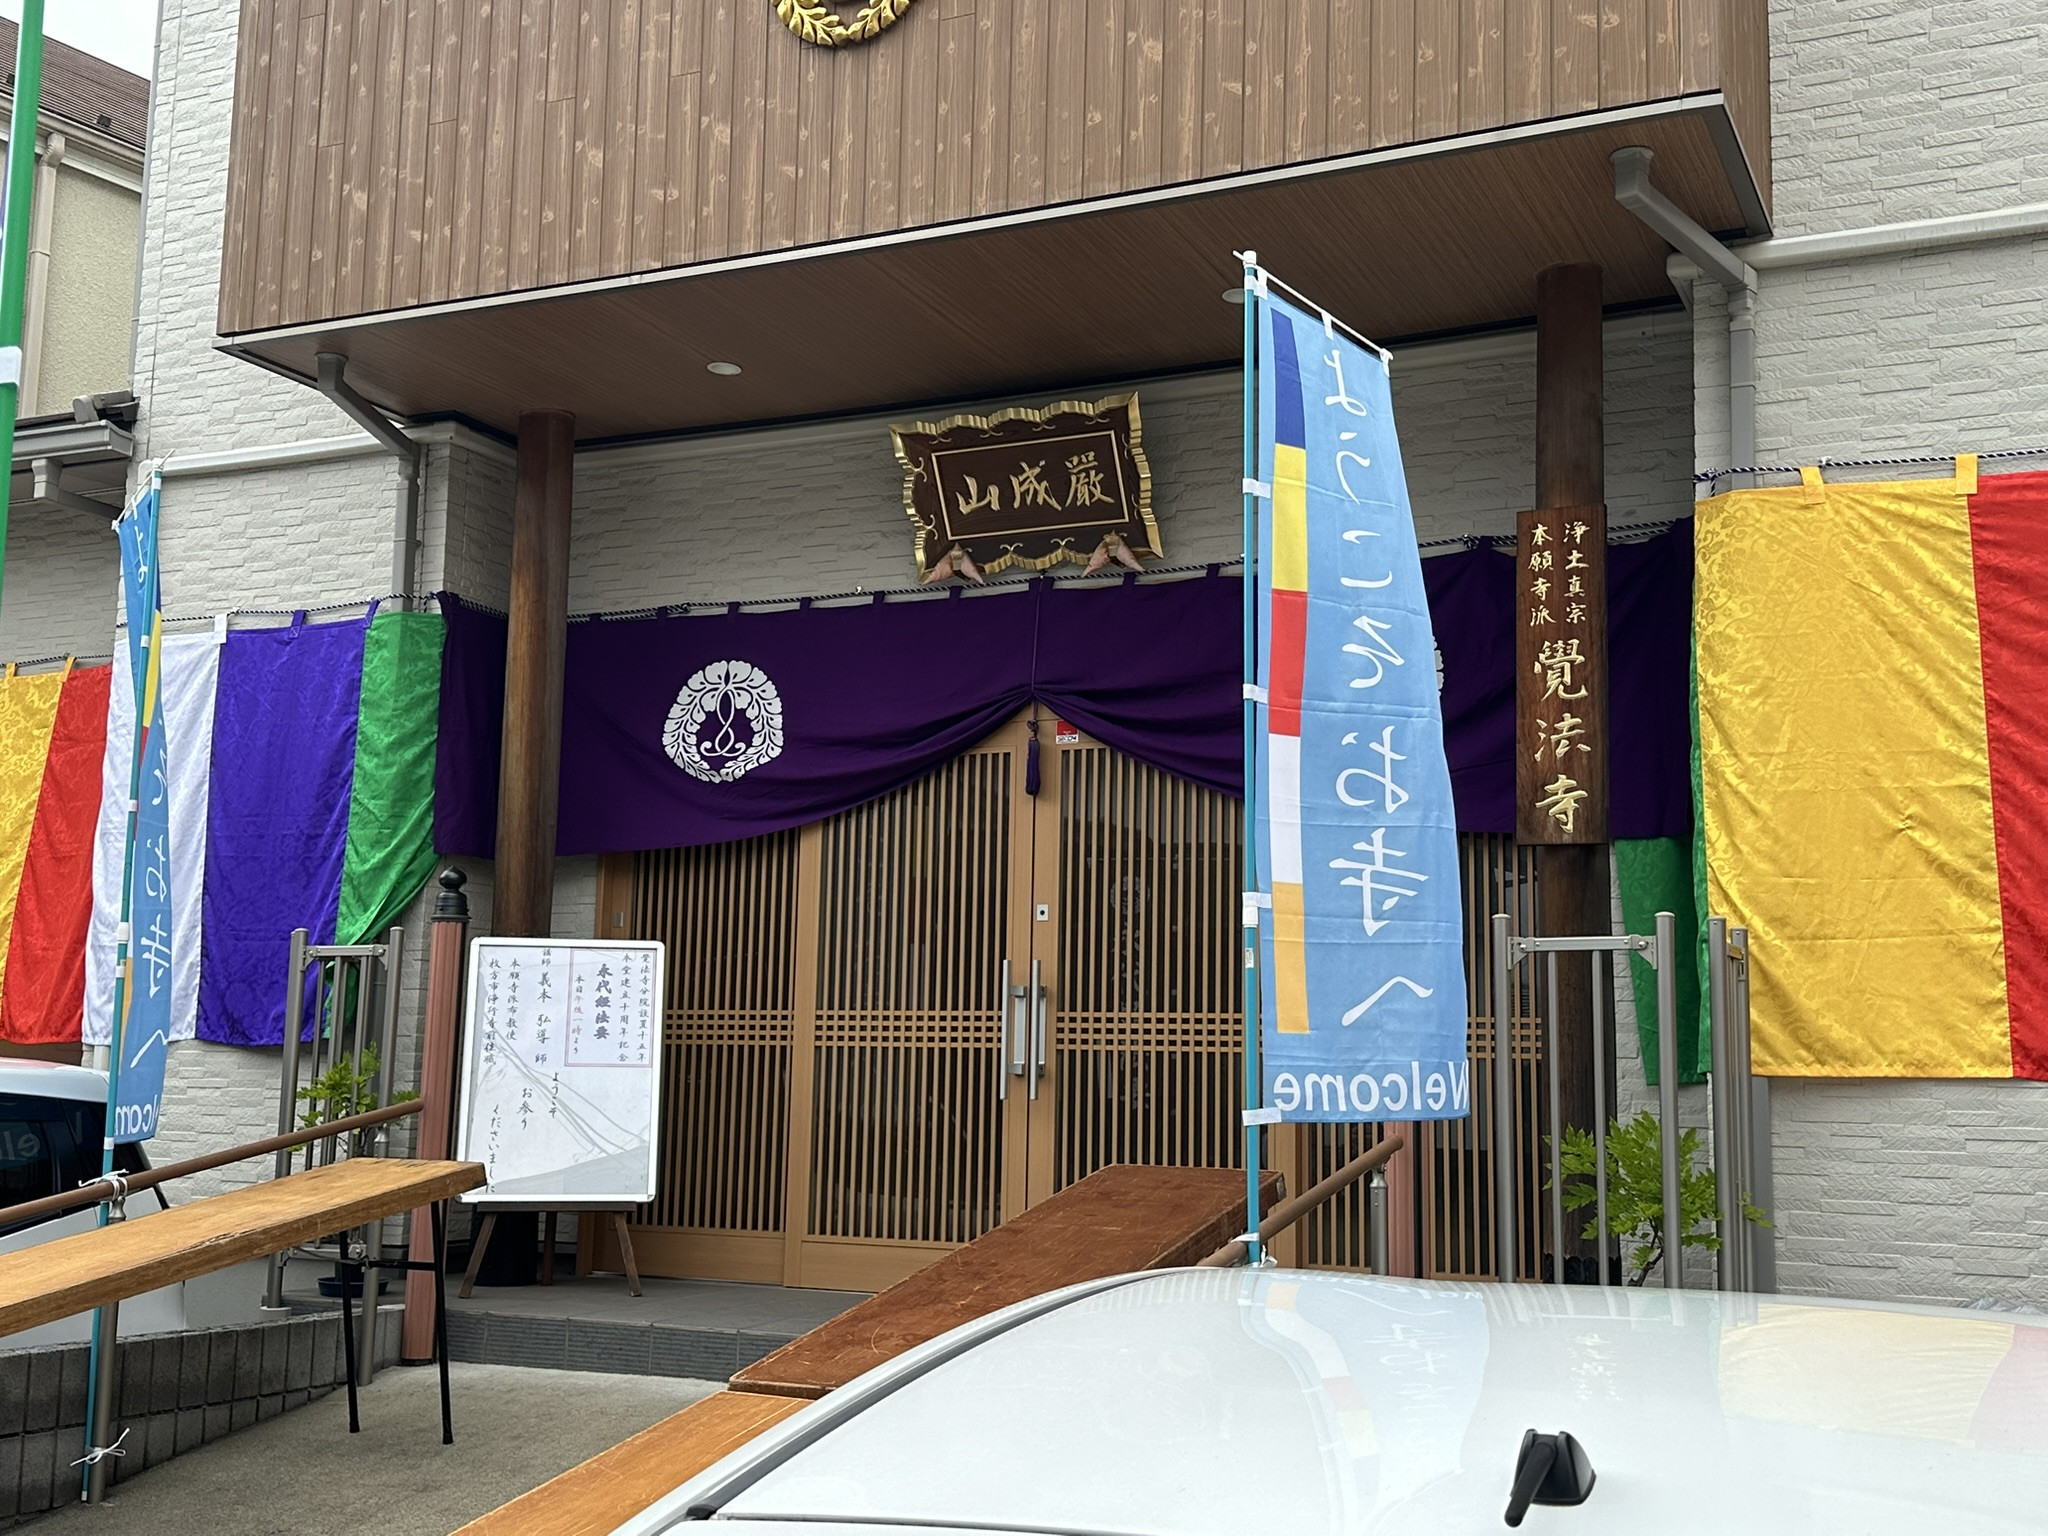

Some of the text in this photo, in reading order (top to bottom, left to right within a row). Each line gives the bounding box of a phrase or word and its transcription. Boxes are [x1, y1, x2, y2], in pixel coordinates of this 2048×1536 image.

[1527, 522, 1557, 627] 本願寺派
[1533, 637, 1592, 835] 覺法寺
[516, 1087, 534, 1130] お参り
[548, 1071, 560, 1119] ようこそ
[485, 1103, 502, 1194] くださいました
